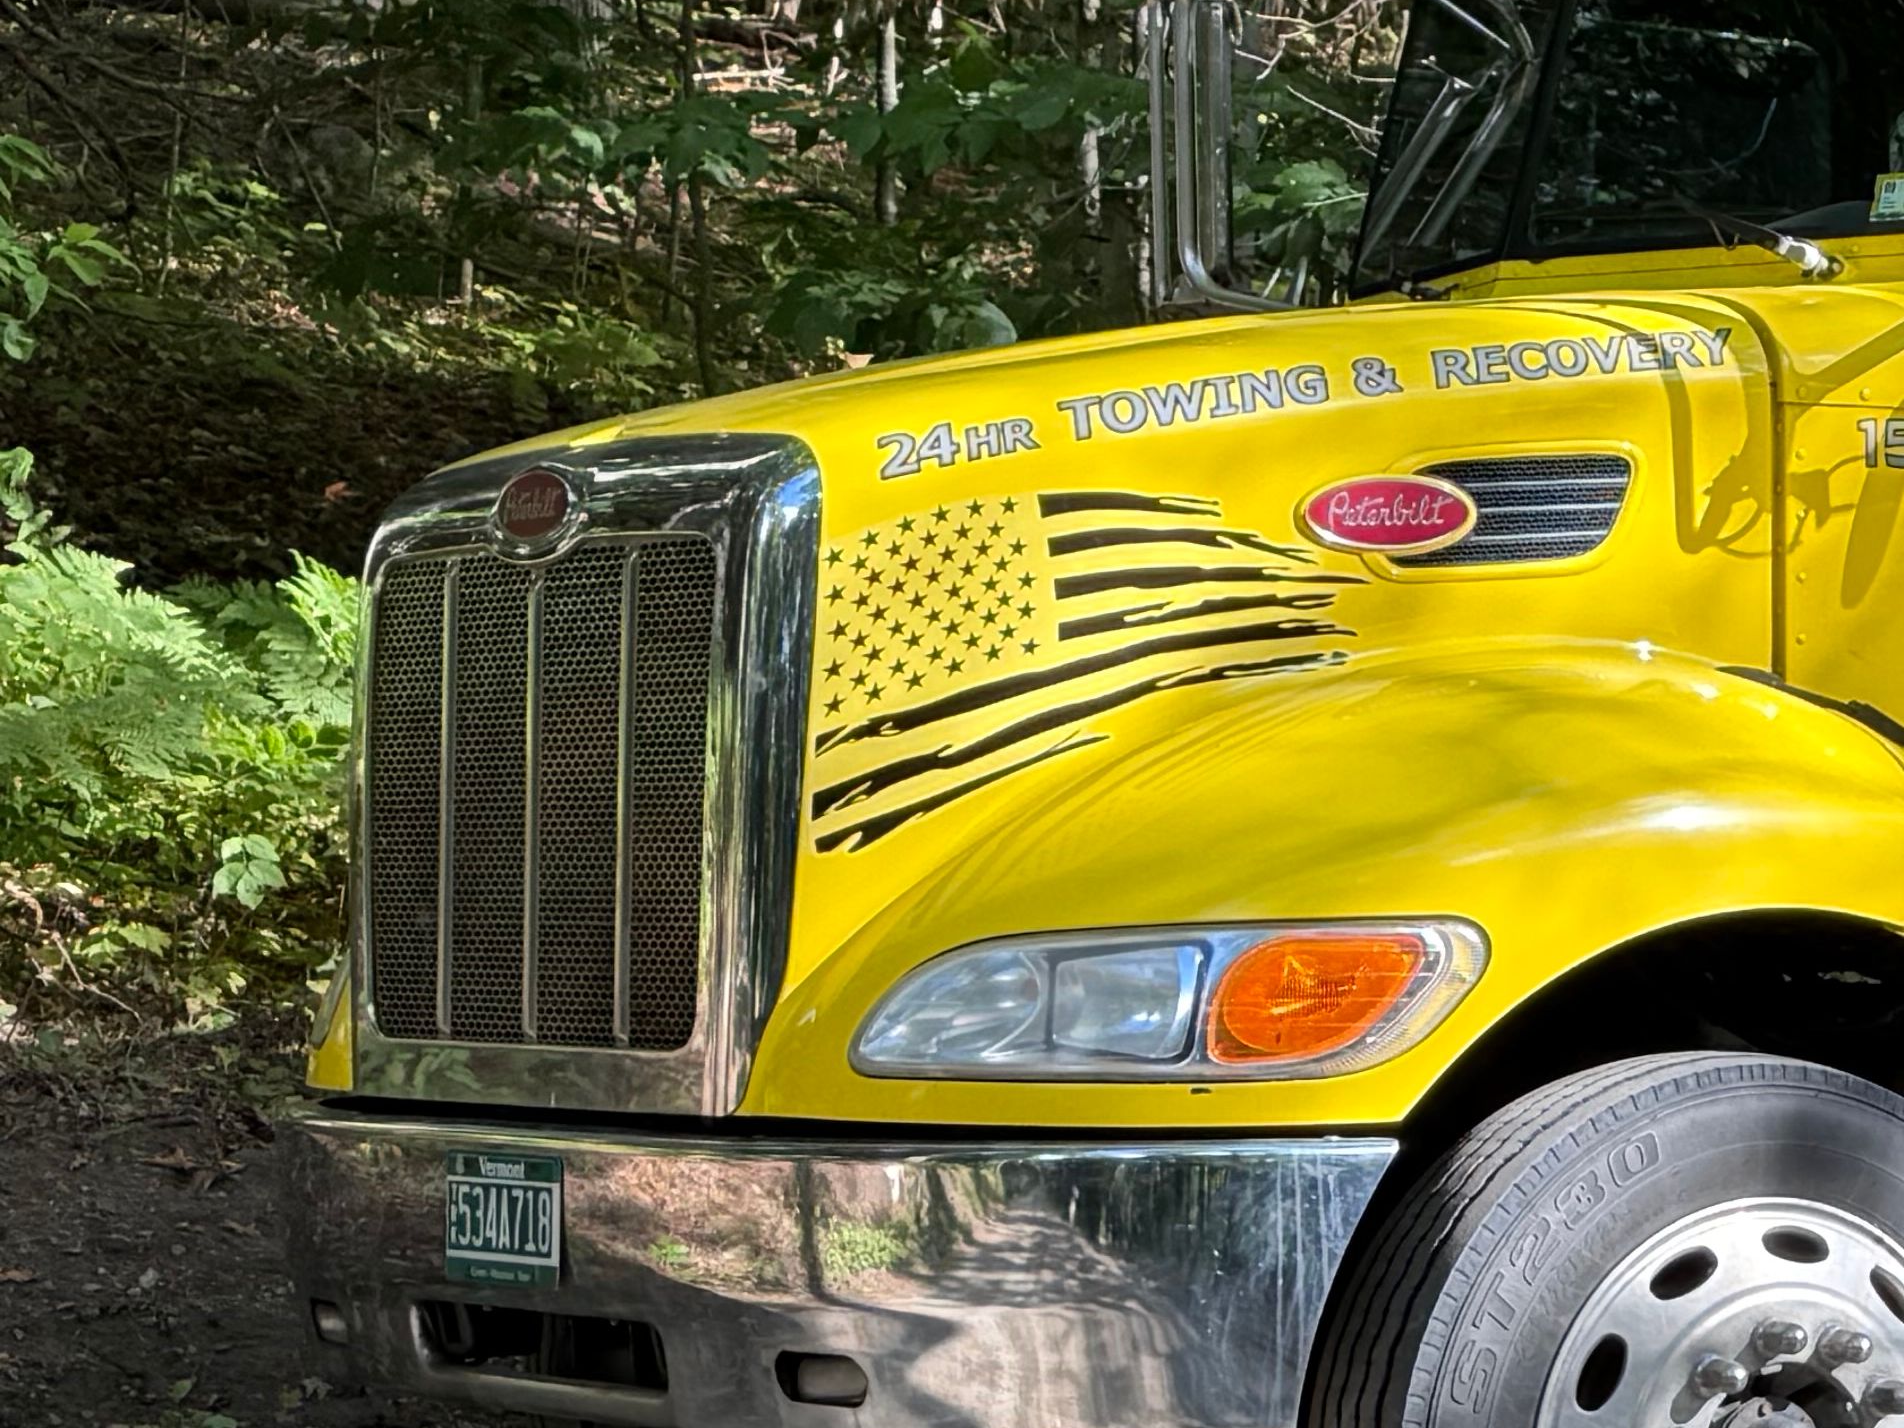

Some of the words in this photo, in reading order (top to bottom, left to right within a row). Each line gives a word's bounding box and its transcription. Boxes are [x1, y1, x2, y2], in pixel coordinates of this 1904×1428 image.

[877, 418, 1041, 481] 24HR
[1057, 365, 1329, 442] TOWING
[1351, 357, 1404, 398] &
[1431, 327, 1732, 390] RECOVERY
[1327, 490, 1455, 532] Peterbilt
[458, 1183, 551, 1254] 534A718
[1449, 1129, 1661, 1415] ST230
